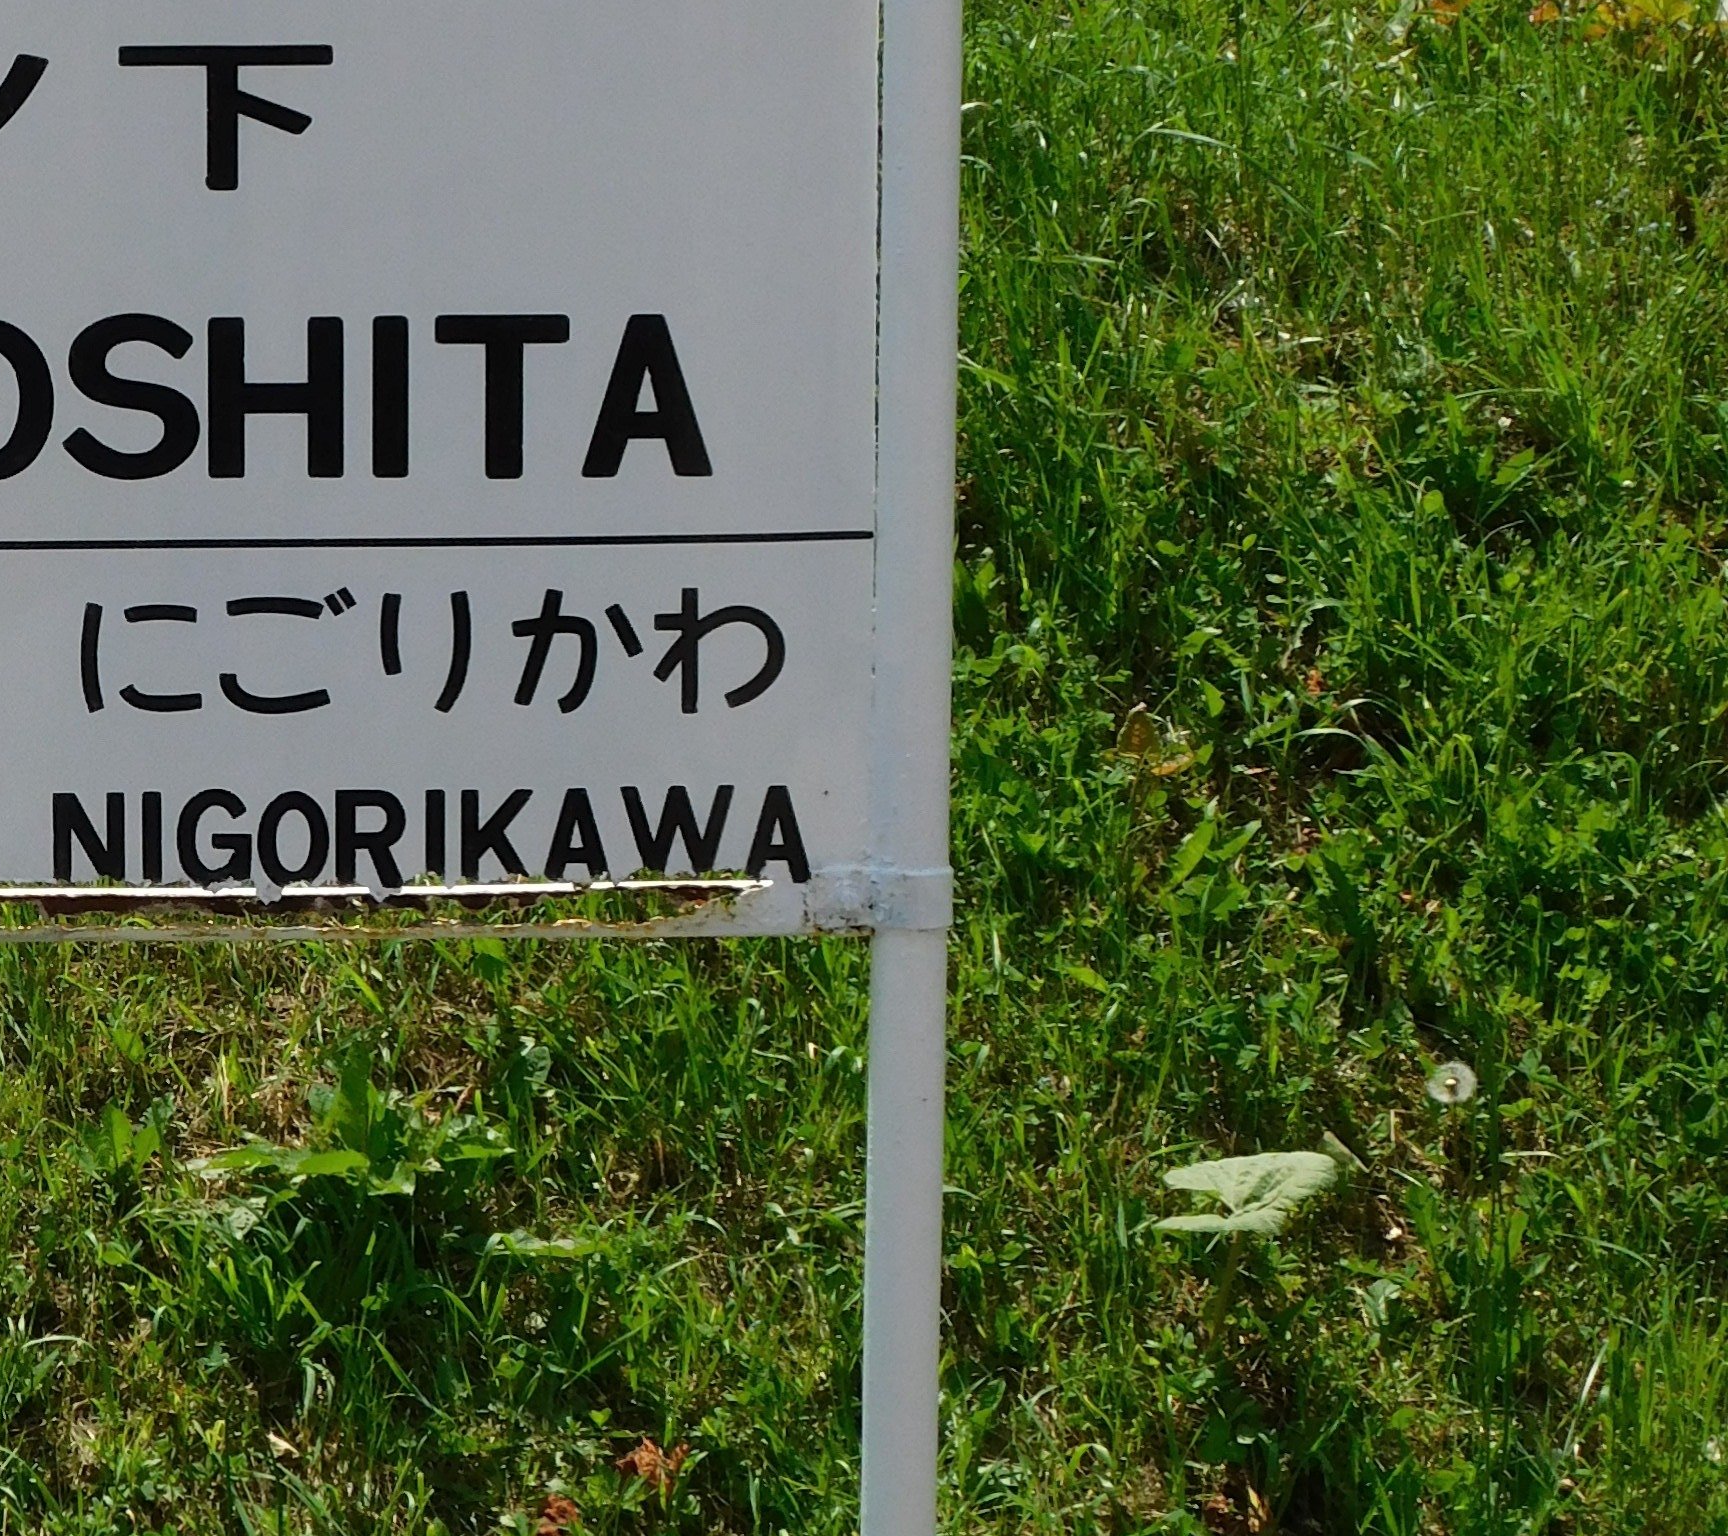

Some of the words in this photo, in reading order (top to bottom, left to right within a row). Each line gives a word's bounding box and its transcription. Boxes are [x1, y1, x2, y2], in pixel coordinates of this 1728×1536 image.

[81, 587, 785, 714] にごりかわ
[52, 785, 811, 888] NIGORIKAWA
